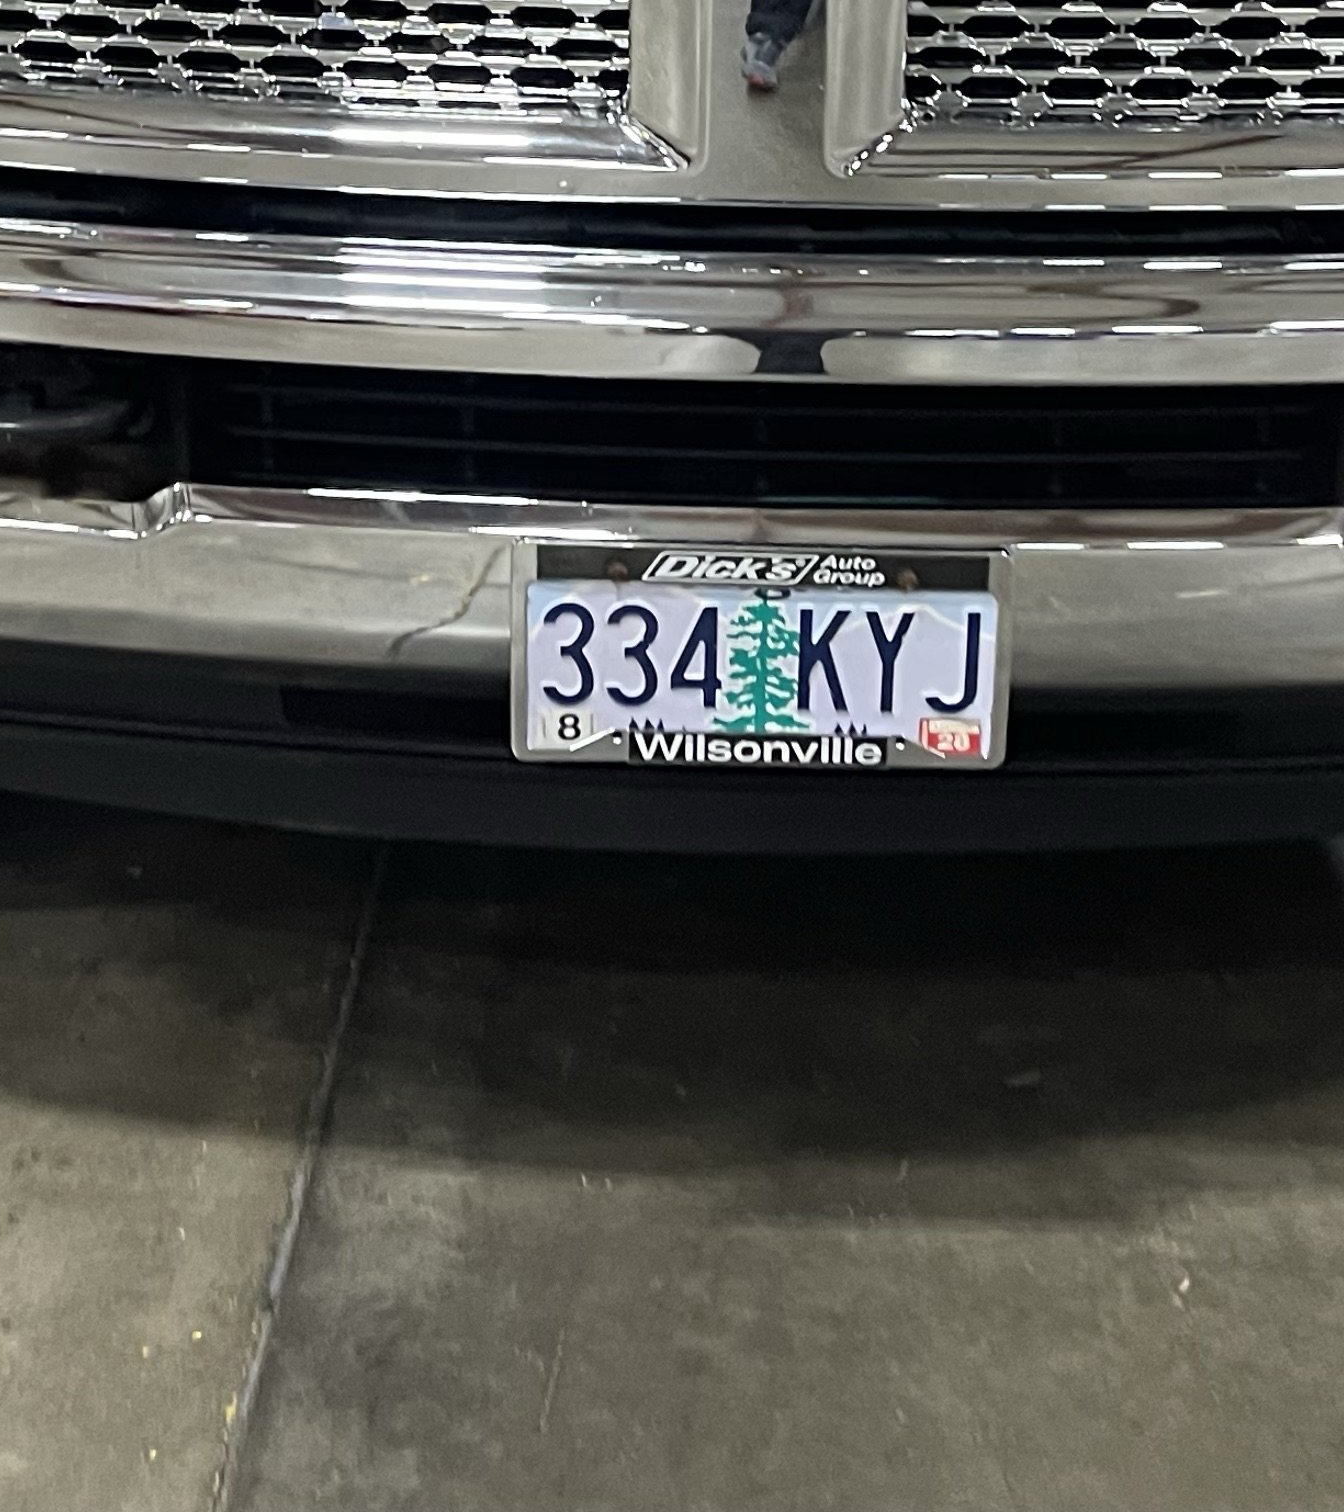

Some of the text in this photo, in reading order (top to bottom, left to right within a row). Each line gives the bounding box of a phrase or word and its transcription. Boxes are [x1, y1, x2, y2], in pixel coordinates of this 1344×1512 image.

[819, 554, 876, 570] Auto
[813, 569, 886, 587] Group
[542, 603, 981, 715] 334 KYJ
[557, 714, 582, 741] 8
[634, 732, 883, 766] Wilsonville
